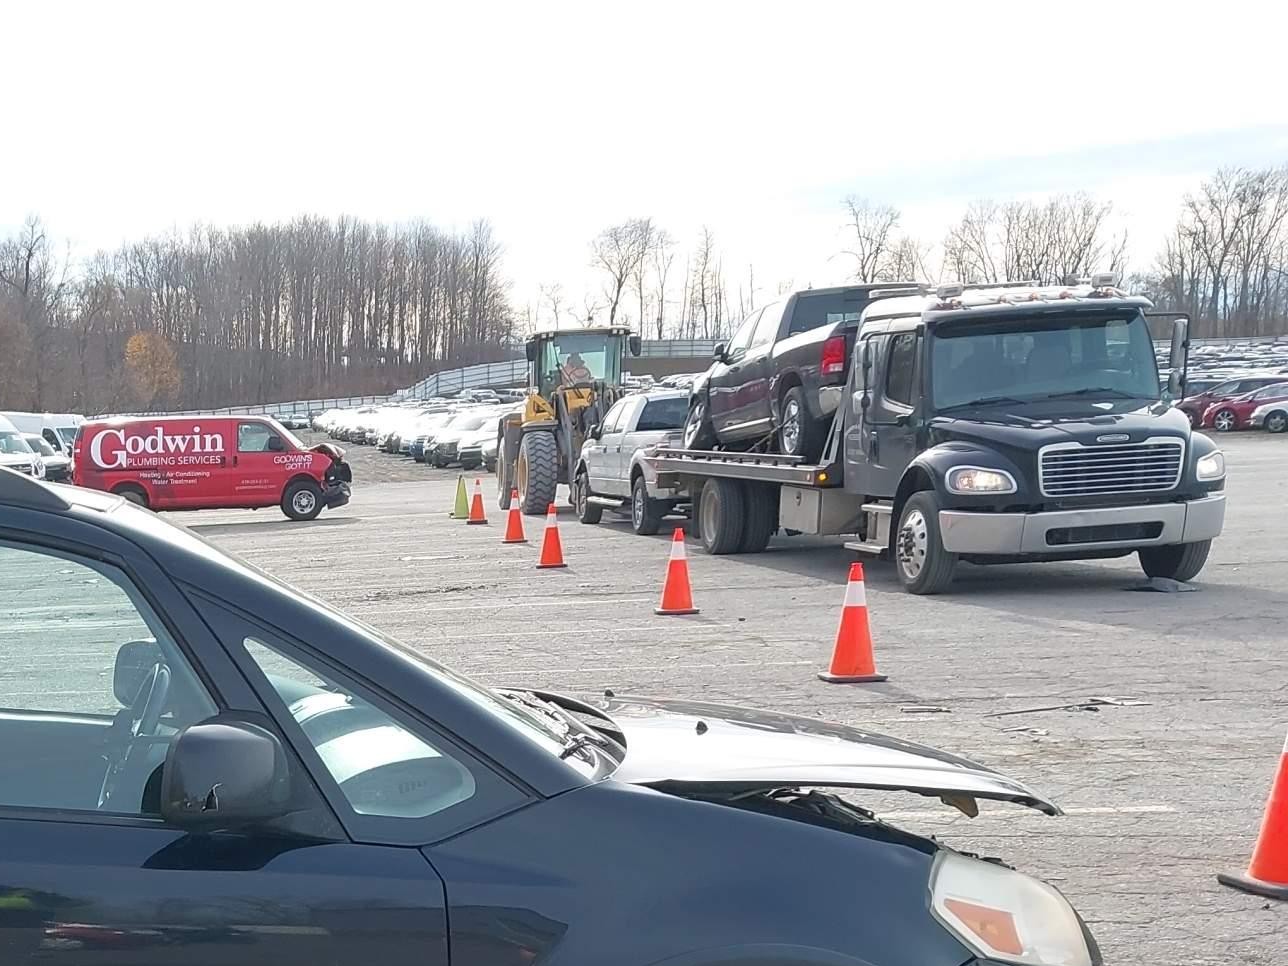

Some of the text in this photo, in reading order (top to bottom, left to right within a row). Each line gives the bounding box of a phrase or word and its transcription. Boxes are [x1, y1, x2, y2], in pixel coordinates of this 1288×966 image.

[90, 426, 225, 468] Godwin
[127, 455, 221, 467] PLUMBING SERVICES
[285, 461, 312, 470] GOT IT
